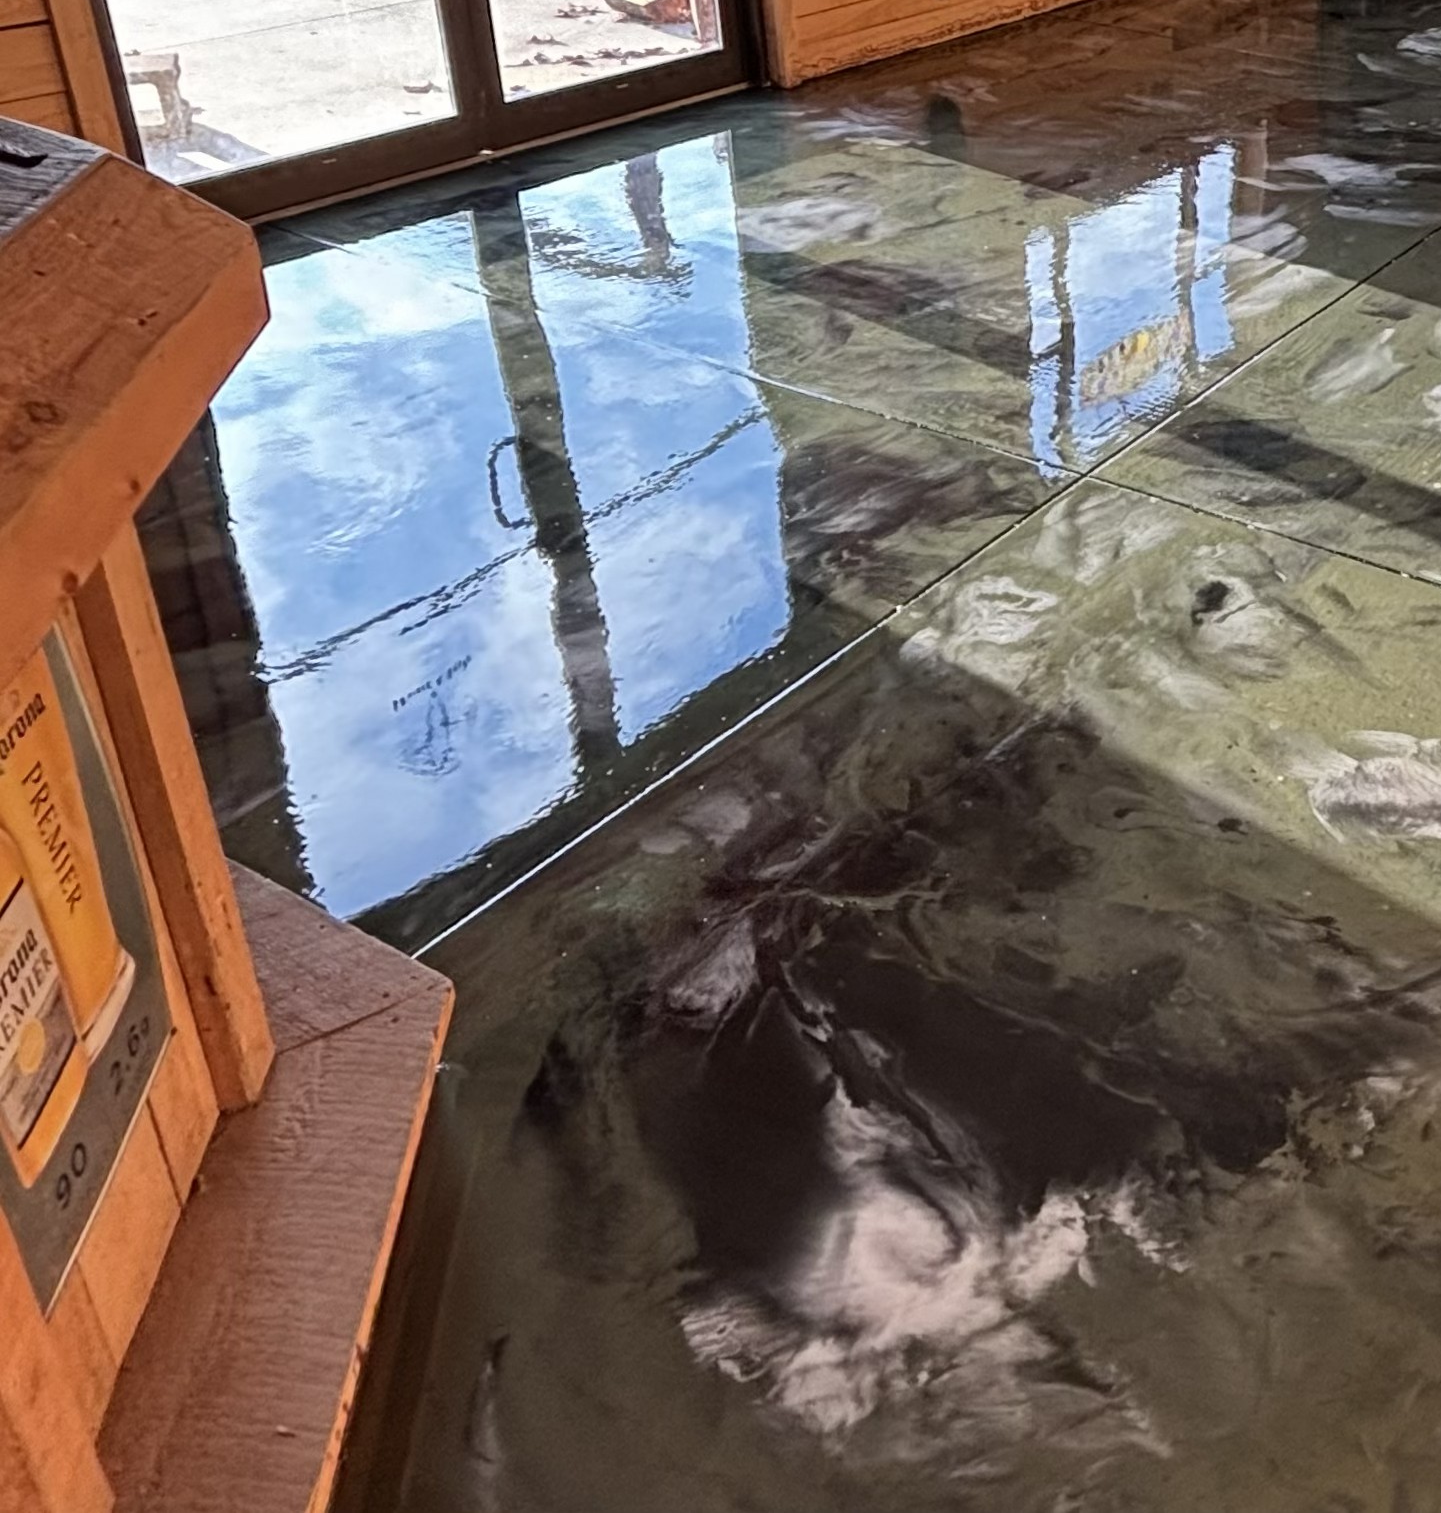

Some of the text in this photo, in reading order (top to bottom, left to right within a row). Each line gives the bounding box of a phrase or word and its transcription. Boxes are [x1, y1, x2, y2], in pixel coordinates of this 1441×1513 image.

[0, 692, 46, 777] orona
[21, 760, 82, 915] PREMIER
[0, 928, 38, 1003] rona
[0, 947, 53, 1052] EMIER
[56, 1142, 87, 1211] 90
